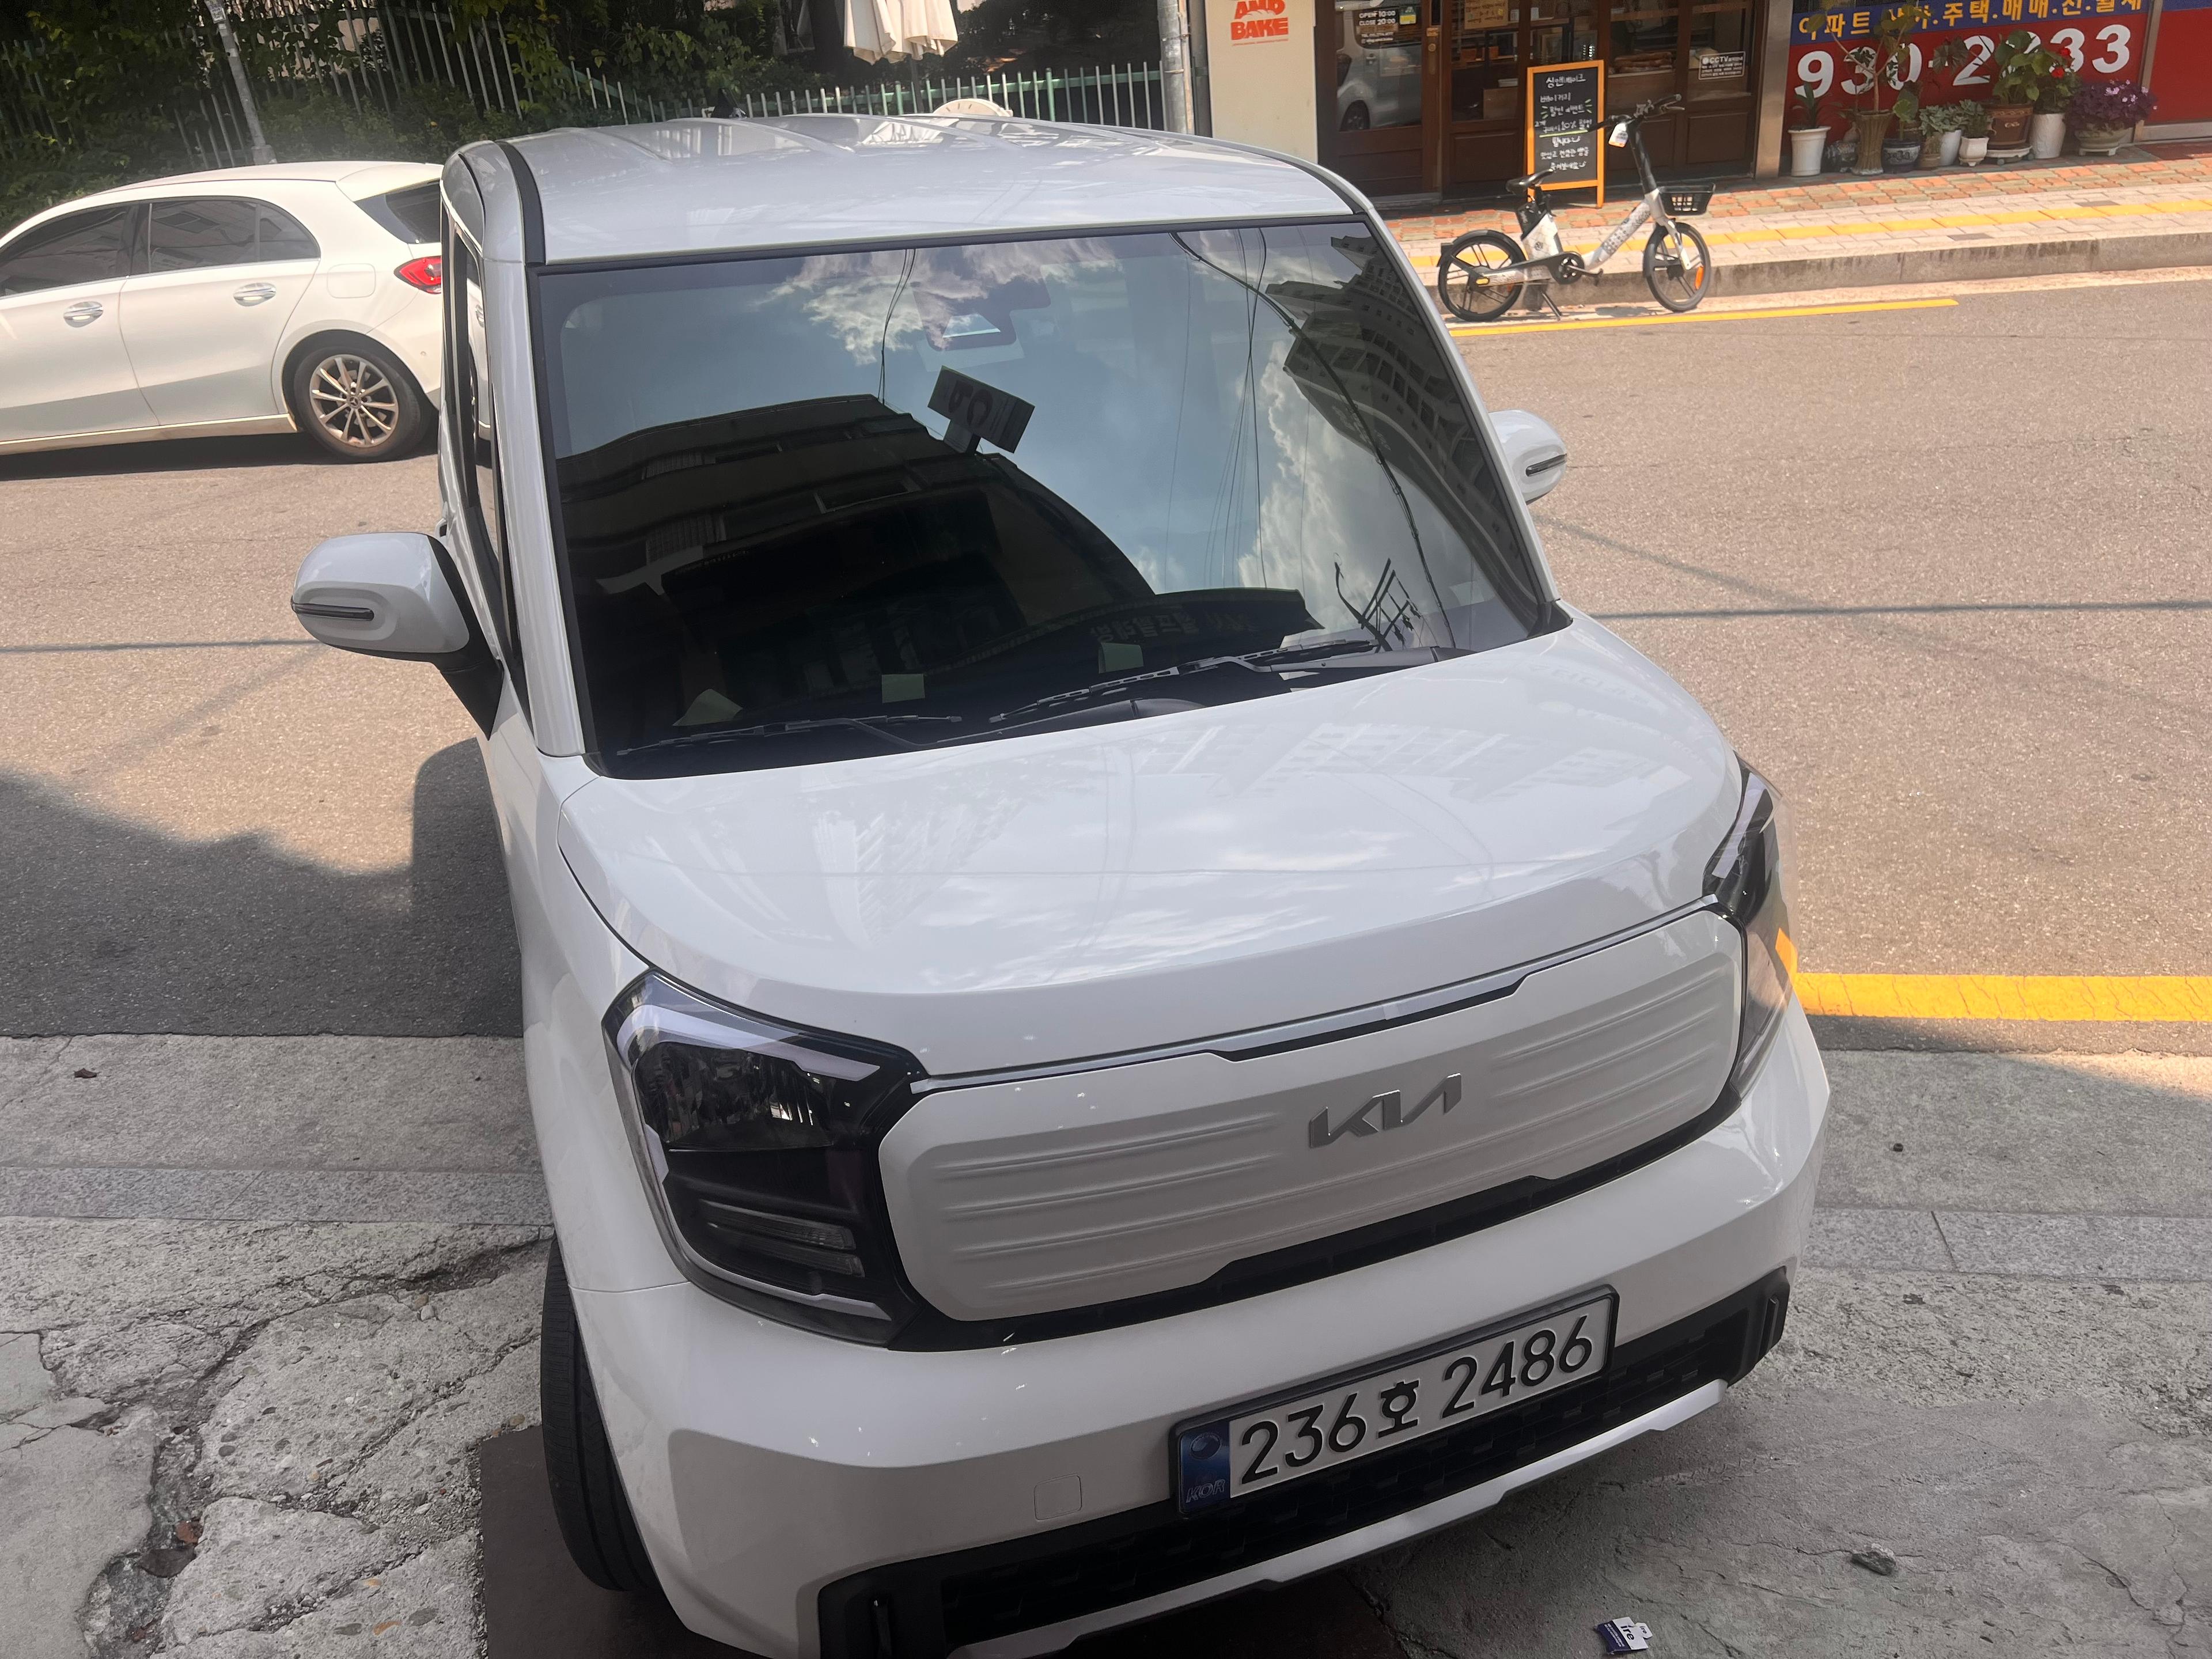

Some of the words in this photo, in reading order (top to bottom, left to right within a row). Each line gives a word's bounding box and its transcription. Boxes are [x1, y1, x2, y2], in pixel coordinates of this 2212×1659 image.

[1230, 17, 1288, 40] BAKE
[1709, 56, 1729, 64] CCTV
[1794, 24, 2131, 98] 930-233
[1309, 1073, 1461, 1148] KIA
[1241, 1381, 1419, 1485] 236호
[1441, 1315, 1593, 1419] 2486
[1185, 1479, 1226, 1503] KOR
